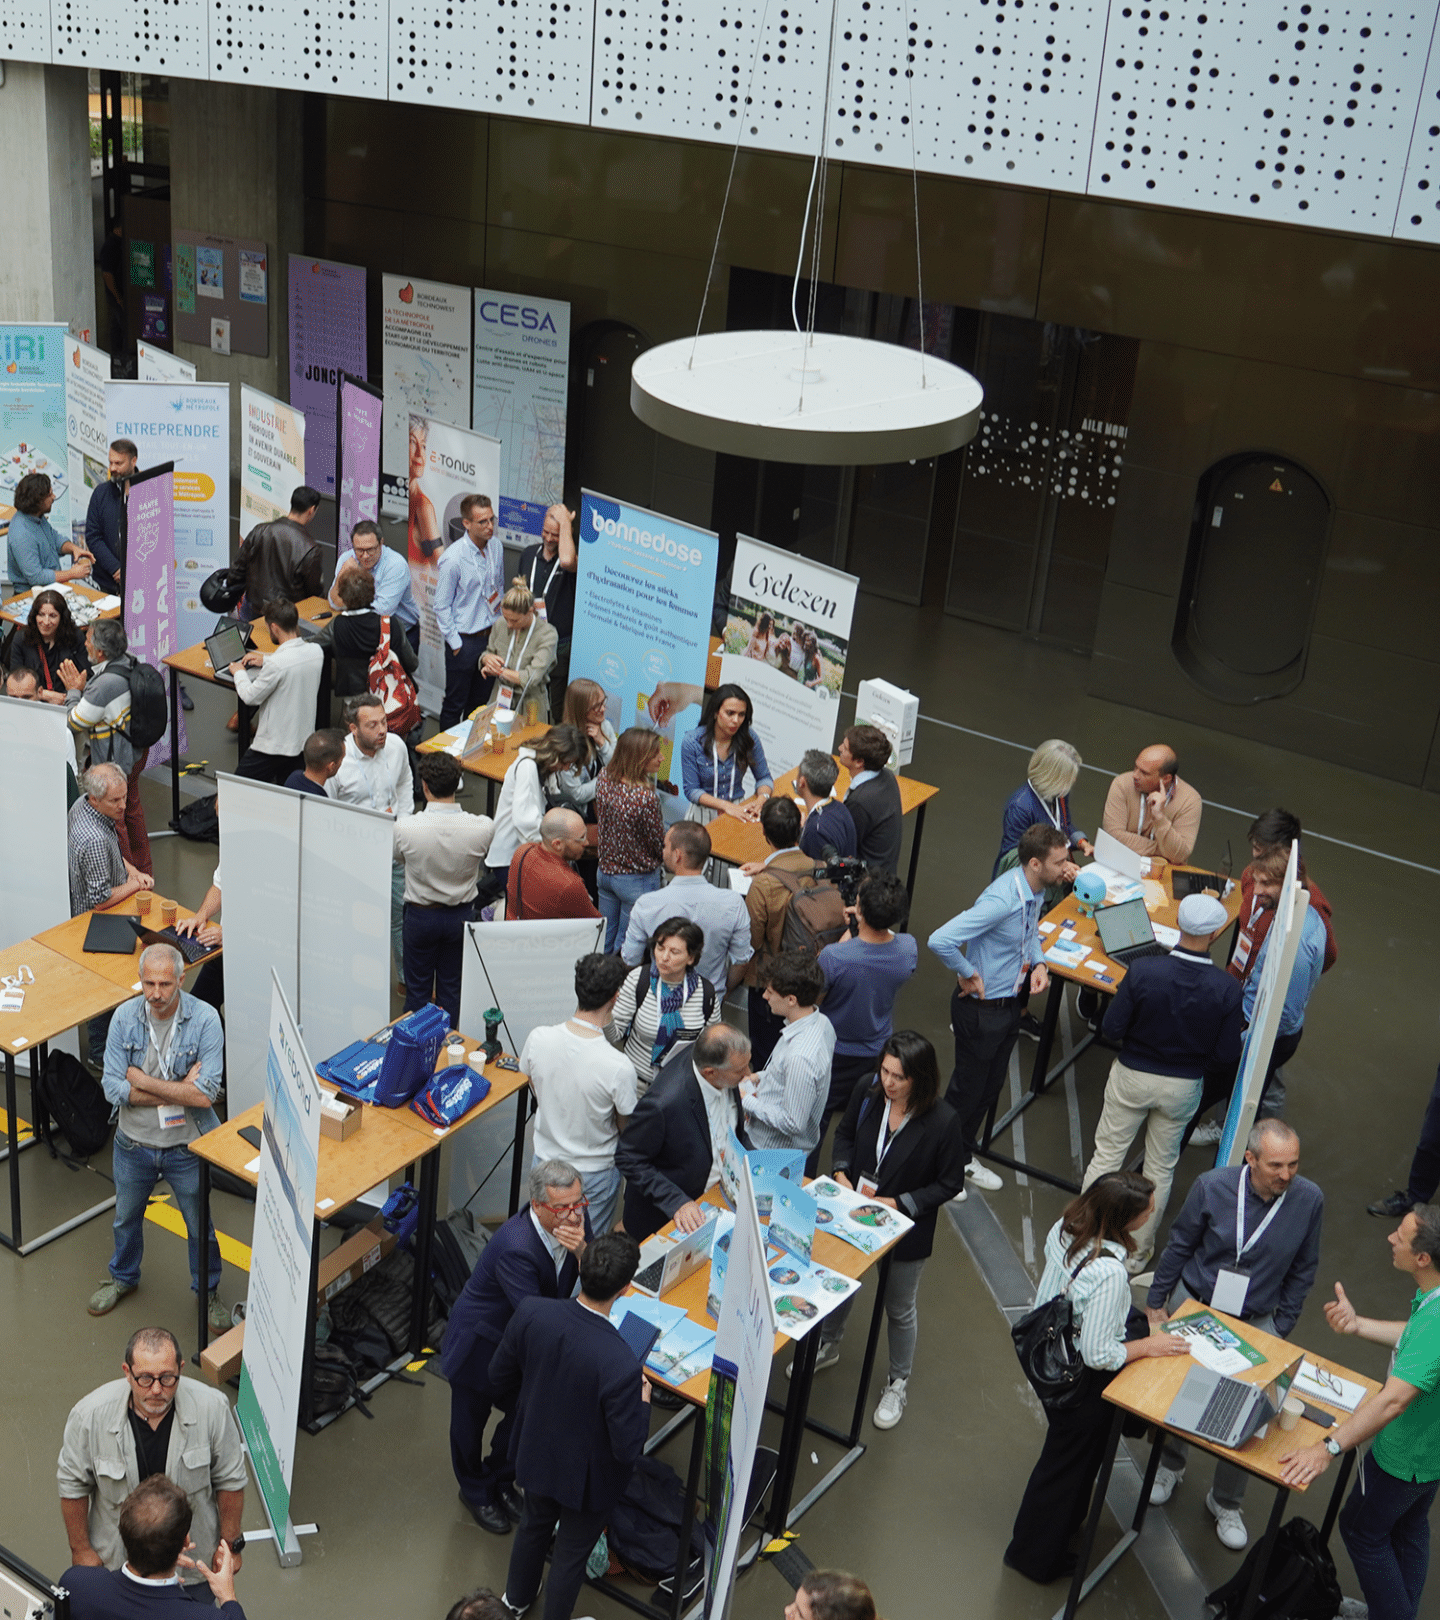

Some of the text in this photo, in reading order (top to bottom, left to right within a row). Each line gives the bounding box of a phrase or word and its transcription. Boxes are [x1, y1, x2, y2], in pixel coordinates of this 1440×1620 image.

[417, 293, 447, 304] BORDEAUX
[417, 301, 456, 312] TECHNOWEST
[393, 309, 430, 321] TECHNOPOLE
[480, 301, 557, 334] CESA
[385, 324, 421, 336] ACCOMPAGNE
[521, 334, 557, 348] DRONES
[431, 347, 461, 359] TERRITOIRE
[476, 344, 493, 352] Centre
[494, 346, 516, 356] d'essais
[522, 352, 552, 363] d'expertise
[503, 355, 522, 364] drones
[529, 361, 548, 369] robots
[248, 403, 288, 435] INDUSTRIE
[1081, 417, 1103, 434] AILE
[115, 421, 221, 438] ENTREPRENDRE
[248, 420, 275, 442] FABRIQUER
[254, 450, 282, 472] SOUVERAIN
[255, 438, 273, 454] AVENIR
[274, 446, 298, 467] DURABLE
[590, 508, 702, 567] bonnedose
[604, 565, 643, 586] Découvrez
[644, 580, 656, 591] les
[657, 585, 679, 600] sticks
[748, 562, 837, 619] Cyclezen
[586, 571, 698, 619] d'hydratation pour les femmes
[588, 600, 611, 615] Arômes
[612, 610, 637, 625] naturels
[644, 621, 659, 632] goût
[660, 628, 699, 648] authentique
[632, 606, 662, 624] Vitamines
[620, 621, 645, 638] fabriqué
[655, 635, 677, 650] France
